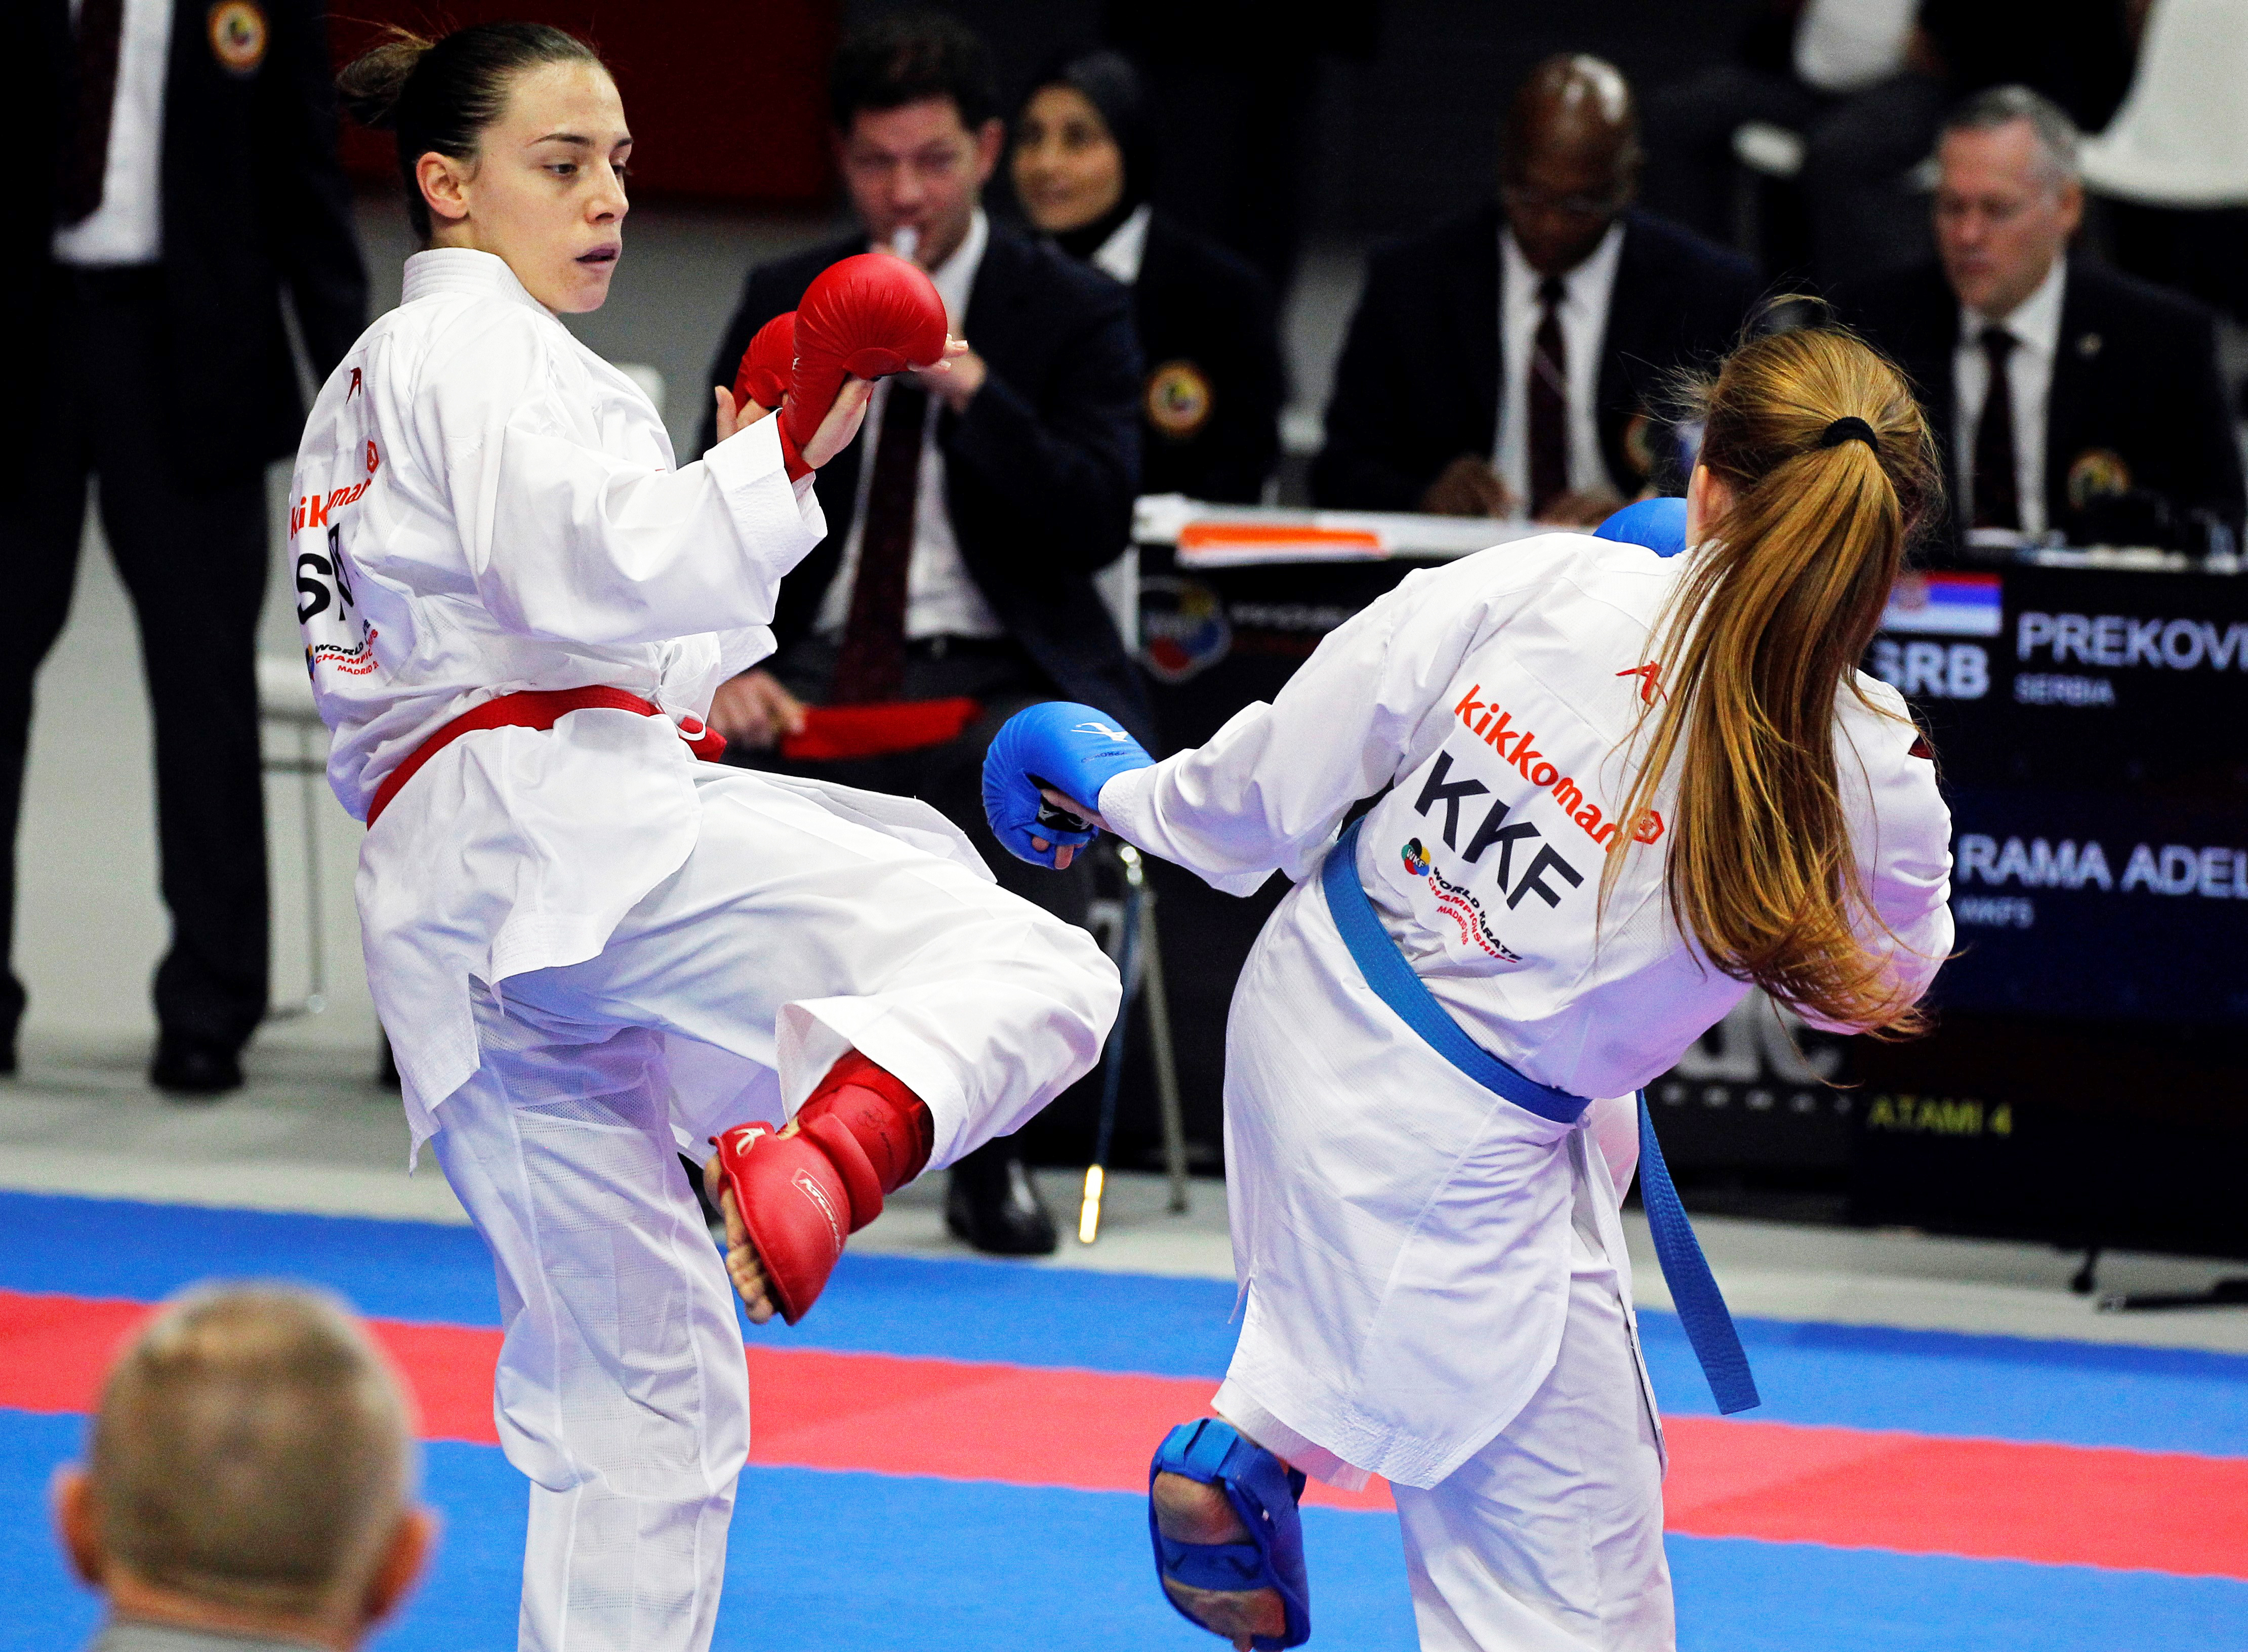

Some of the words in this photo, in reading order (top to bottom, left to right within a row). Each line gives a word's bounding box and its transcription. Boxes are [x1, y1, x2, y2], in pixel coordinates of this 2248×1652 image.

[315, 641, 363, 655] WORLD
[337, 665, 372, 675] MADRID
[1873, 640, 1990, 699] SRB
[1454, 684, 1623, 853] kikkoman
[1406, 848, 1426, 868] WKF
[1414, 750, 1584, 910] KKF
[1956, 834, 2113, 891] RAMA
[1428, 877, 1518, 963] CHAMPIONSHIPS
[1434, 866, 1480, 908] WORLD
[1479, 911, 1523, 960] KARATE
[1437, 905, 1467, 929] MADRID
